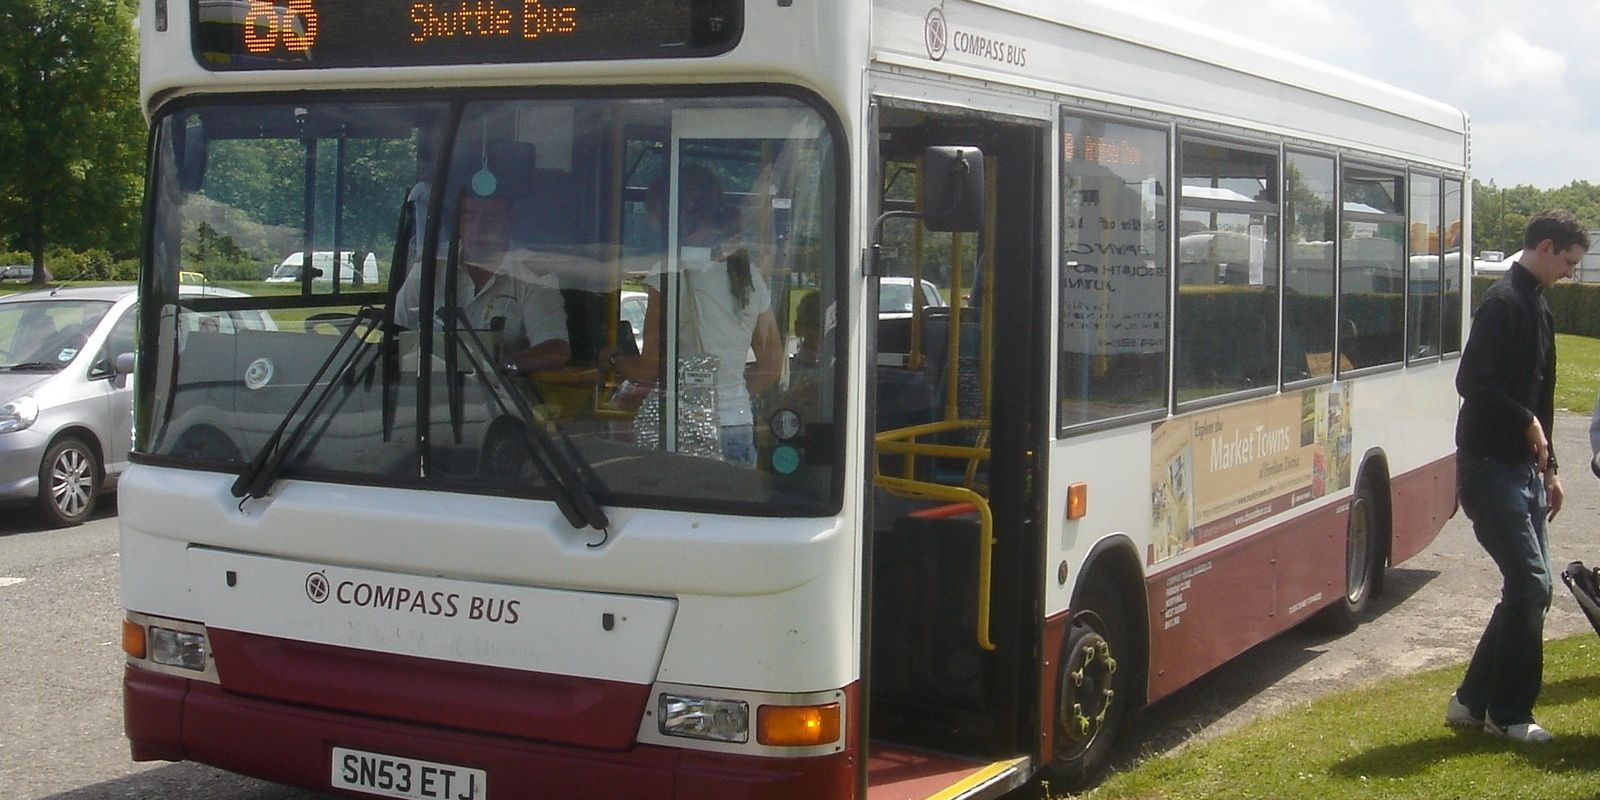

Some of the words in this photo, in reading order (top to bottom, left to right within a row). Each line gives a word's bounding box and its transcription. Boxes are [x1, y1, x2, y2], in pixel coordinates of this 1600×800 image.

[411, 0, 513, 42] Shuttle
[524, 0, 576, 39] Bus
[953, 31, 1004, 62] COMPASS
[1006, 45, 1026, 67] BUS
[1210, 429, 1254, 473] Market
[1255, 424, 1290, 459] Towns
[336, 581, 460, 618] COMPASS
[468, 596, 521, 624] BUS
[343, 754, 412, 793] SN53
[421, 766, 475, 800] ETJ
